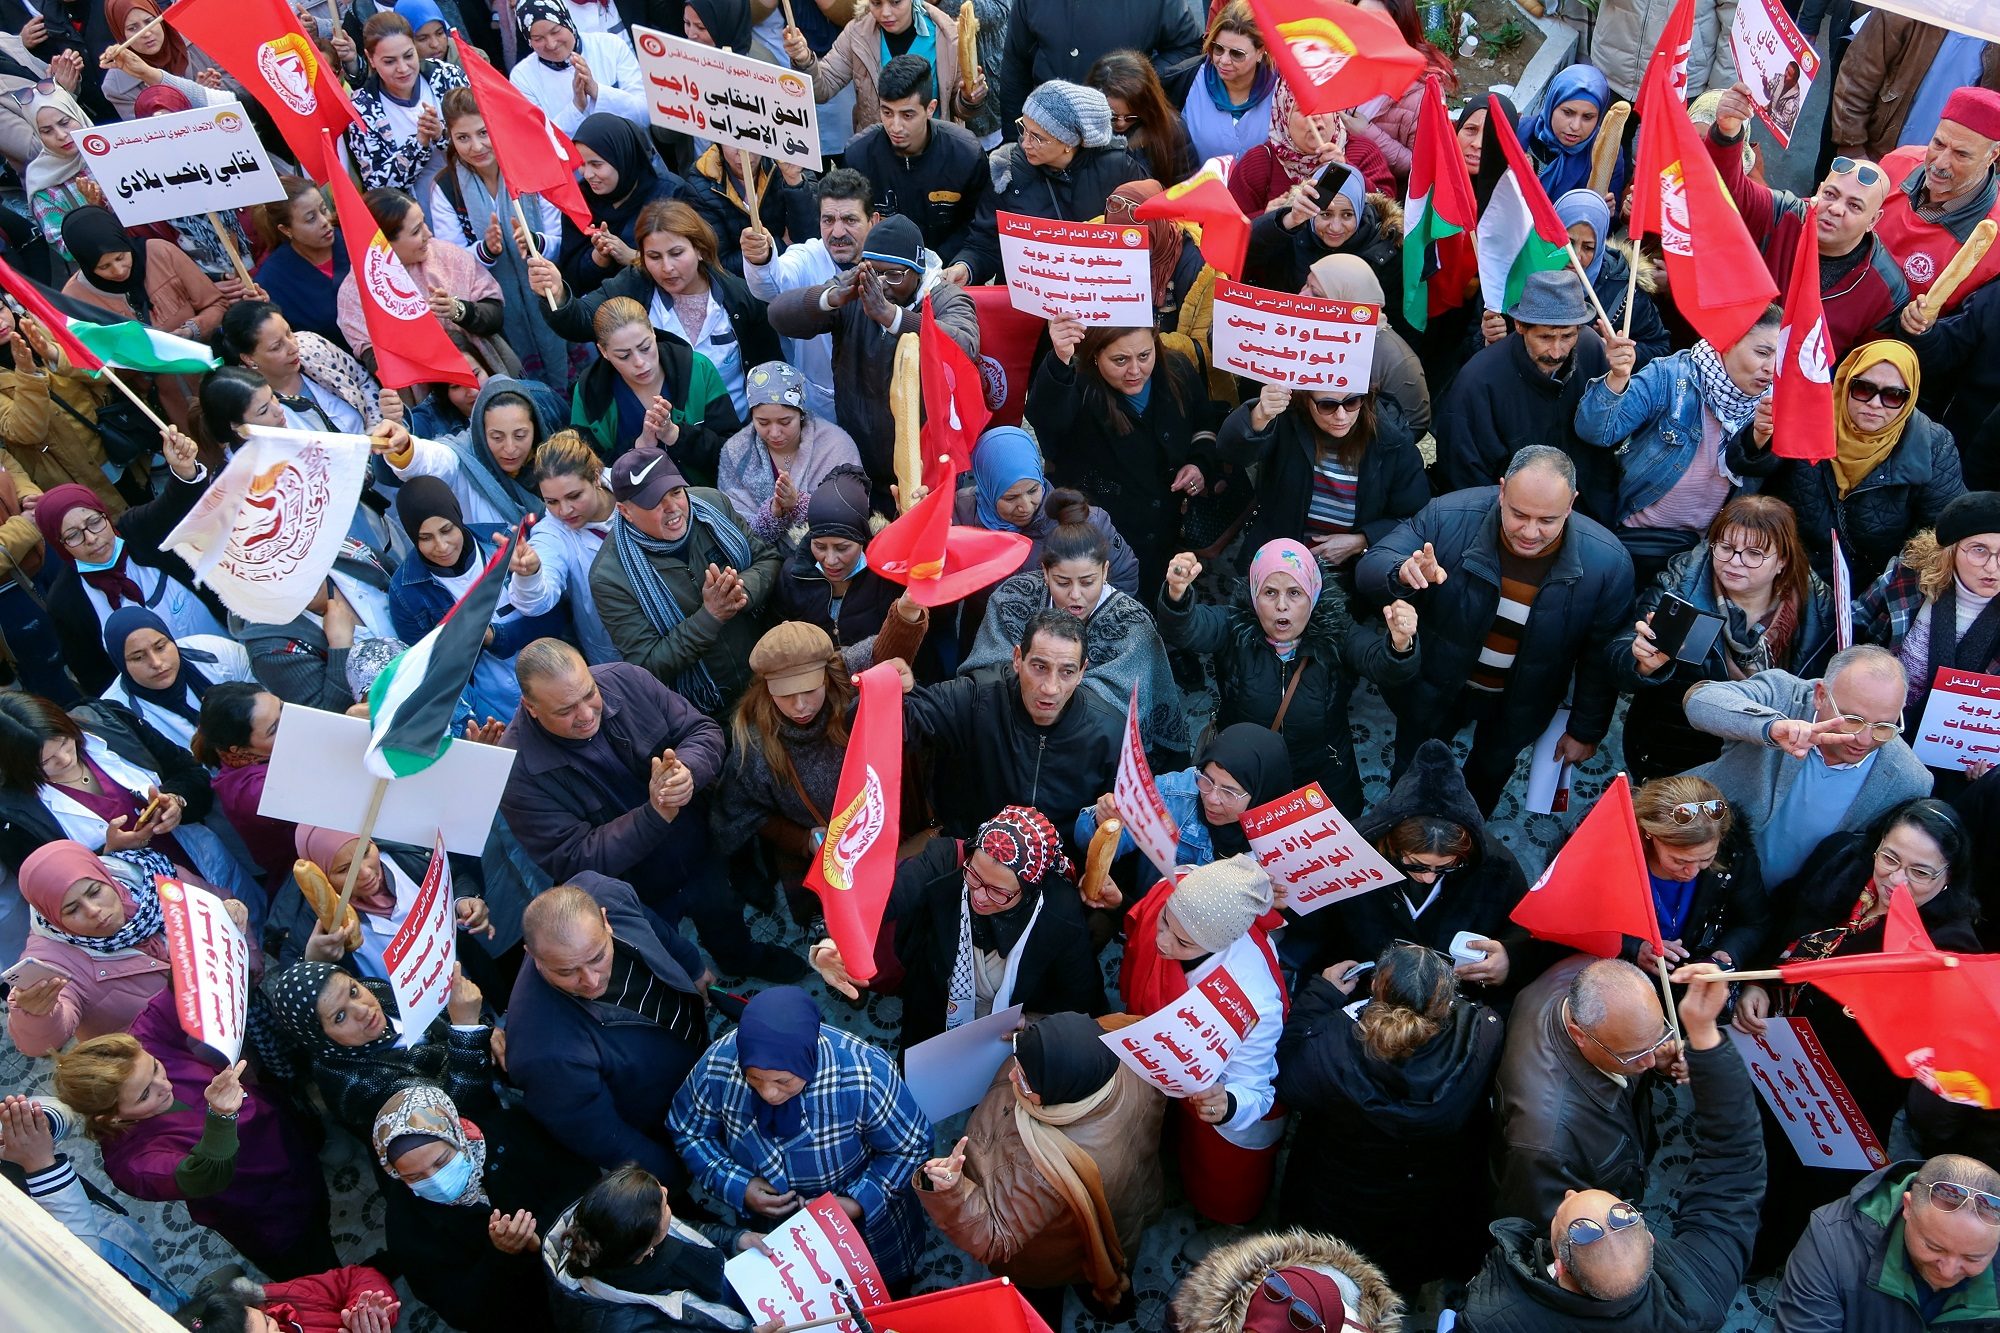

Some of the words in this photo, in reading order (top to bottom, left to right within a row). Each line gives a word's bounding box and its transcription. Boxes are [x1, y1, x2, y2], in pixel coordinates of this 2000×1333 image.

[649, 71, 699, 102] واجب
[656, 99, 706, 130] واجب
[704, 87, 766, 117] النقابي
[772, 100, 809, 129] الحق
[709, 114, 778, 150] الإضراب
[783, 130, 809, 156] حق
[163, 160, 213, 190] ونحب
[214, 149, 260, 188] نقابي
[115, 168, 165, 205] بلادي
[1005, 219, 1031, 232] للشغل
[1033, 227, 1067, 238] التونسي
[1069, 229, 1089, 241] العام
[1022, 246, 1065, 264] تربوية
[1069, 253, 1123, 268] منظومة
[1018, 263, 1070, 282] لتطلعات
[1074, 274, 1131, 287] تستجيب
[1011, 278, 1041, 297] وذات
[1044, 288, 1097, 304] التونسي
[1101, 291, 1145, 305] الشعب
[1223, 286, 1253, 300] للشغل
[1255, 298, 1293, 310] التونسي
[1295, 302, 1316, 313] العام
[1227, 314, 1266, 336] بين
[1274, 322, 1362, 345] المساواة
[1238, 339, 1346, 366] المواطنين
[1227, 356, 1348, 388] والمواطنات
[1945, 675, 1980, 688] للشغل
[1924, 733, 1963, 750] وذات
[1255, 811, 1274, 832] التونسي
[1281, 819, 1341, 853] المساواة
[1258, 846, 1286, 868] بين
[1284, 845, 1354, 884] المواطنين
[1297, 867, 1384, 903] والمواطنات
[391, 927, 411, 963] للشغل
[1206, 977, 1230, 995] للشغل
[1176, 1006, 1206, 1032] بين
[1796, 1026, 1821, 1056] للشغل
[1153, 1031, 1214, 1084] المواطنين
[1812, 1057, 1842, 1093] التونسي
[1791, 1057, 1842, 1135] نقابية
[1835, 1094, 1855, 1115] العام
[1777, 1069, 1833, 1156] وبلادي
[818, 1207, 848, 1235] للشغل
[837, 1238, 869, 1276] التونسي
[859, 1276, 881, 1301] العام
